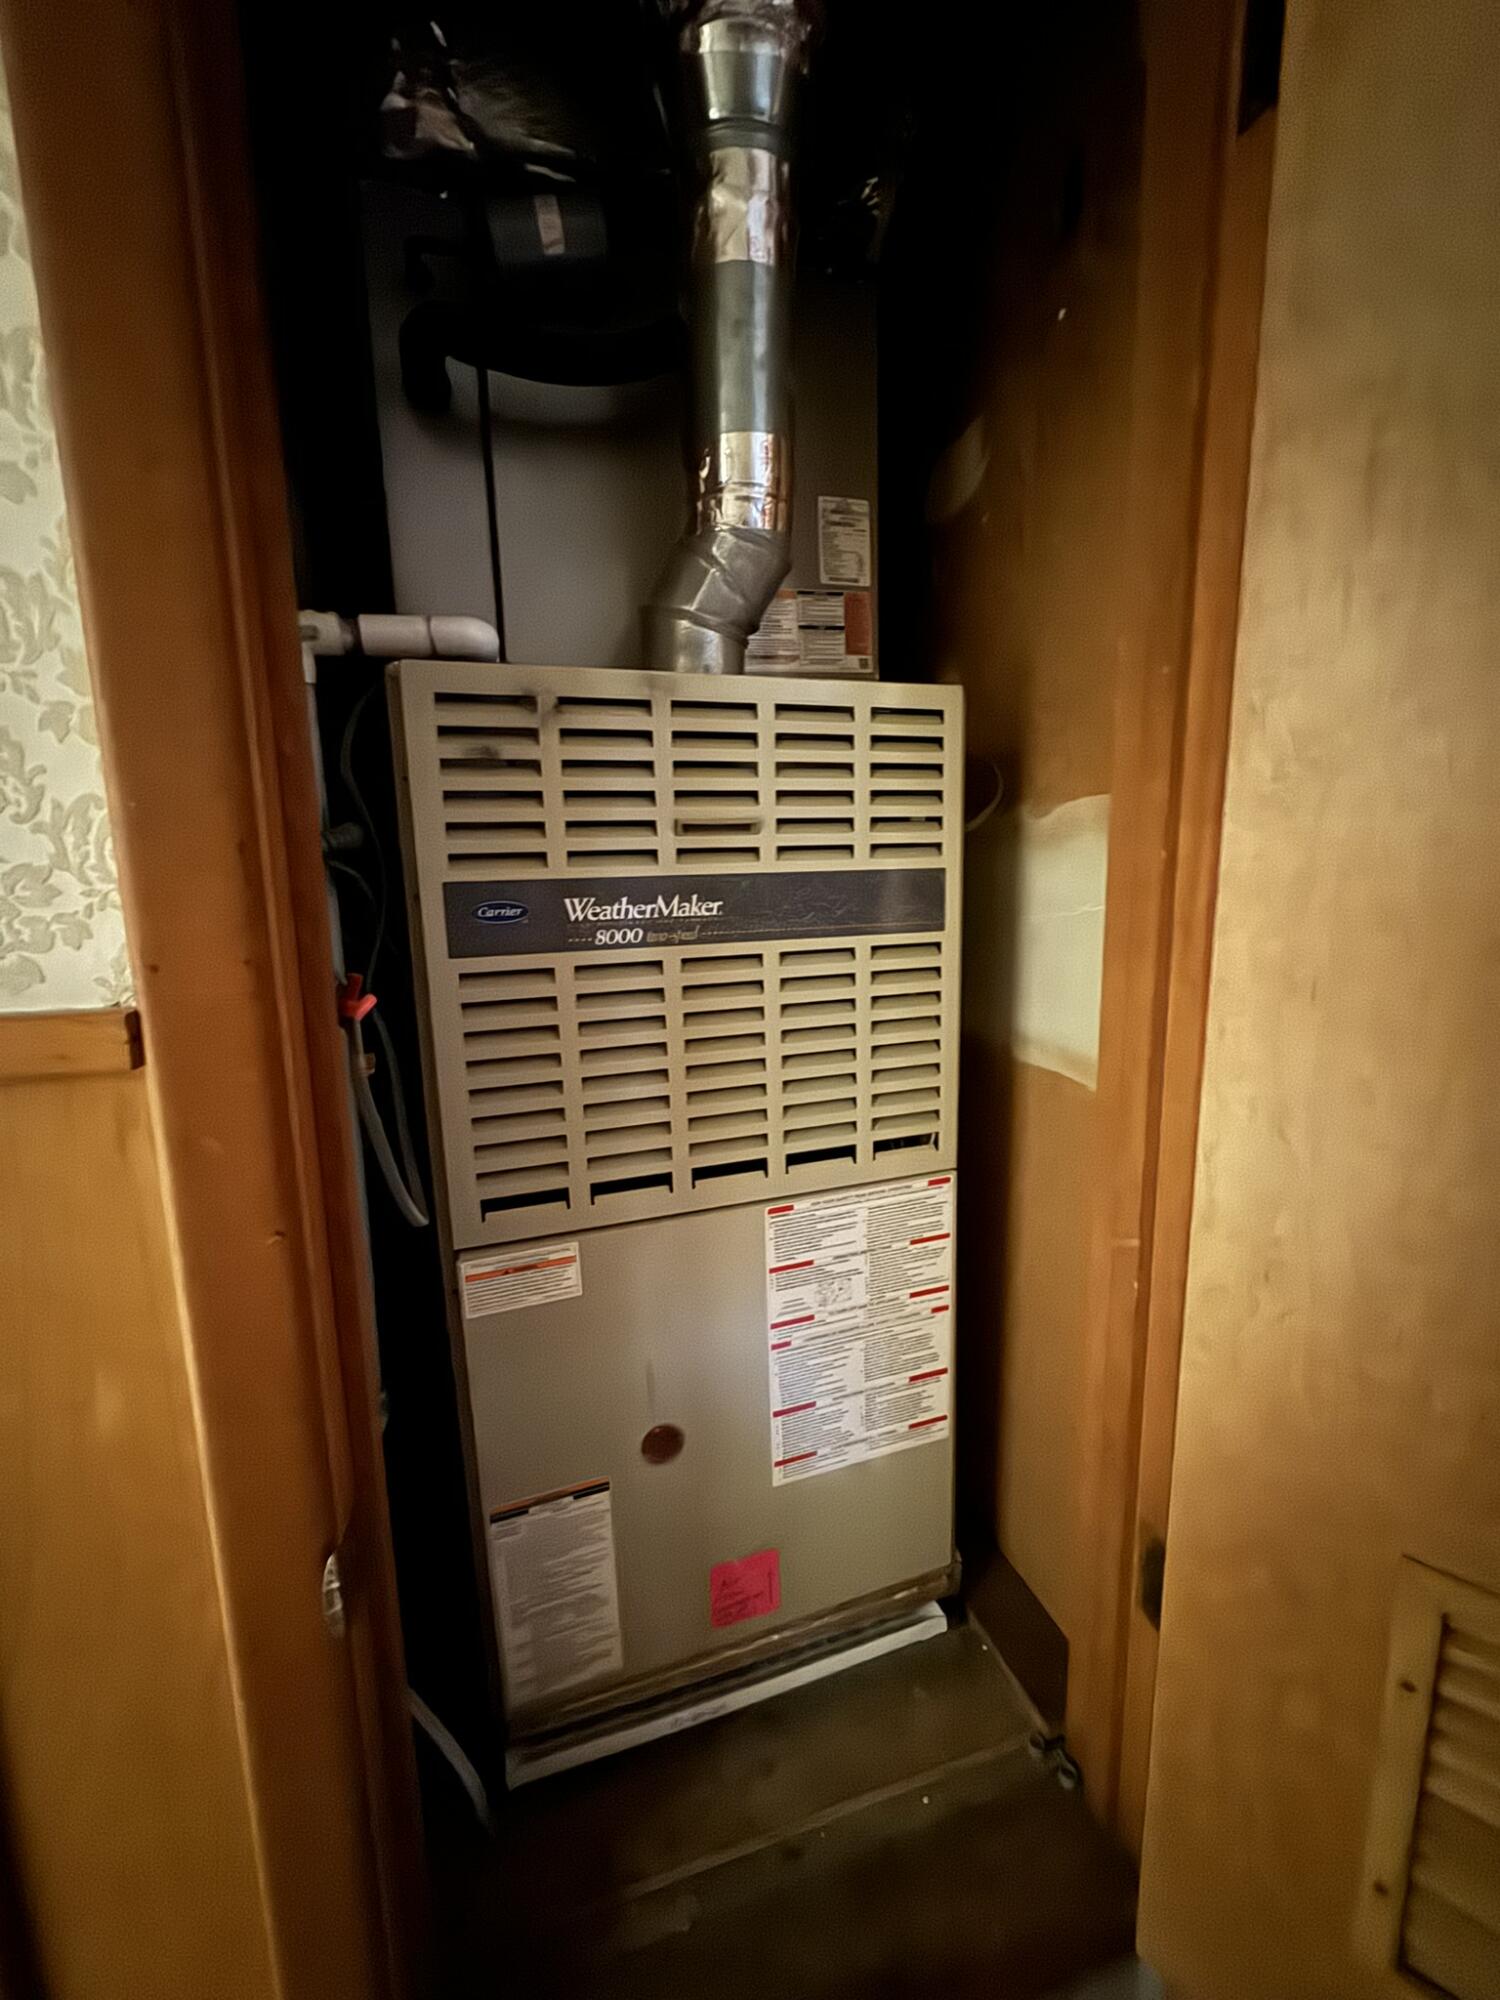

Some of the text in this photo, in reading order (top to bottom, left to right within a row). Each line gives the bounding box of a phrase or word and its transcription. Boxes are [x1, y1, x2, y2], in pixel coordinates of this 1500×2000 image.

[477, 906, 523, 918] Carrier
[564, 894, 724, 922] WeatherMaker
[595, 928, 644, 946] 8000
